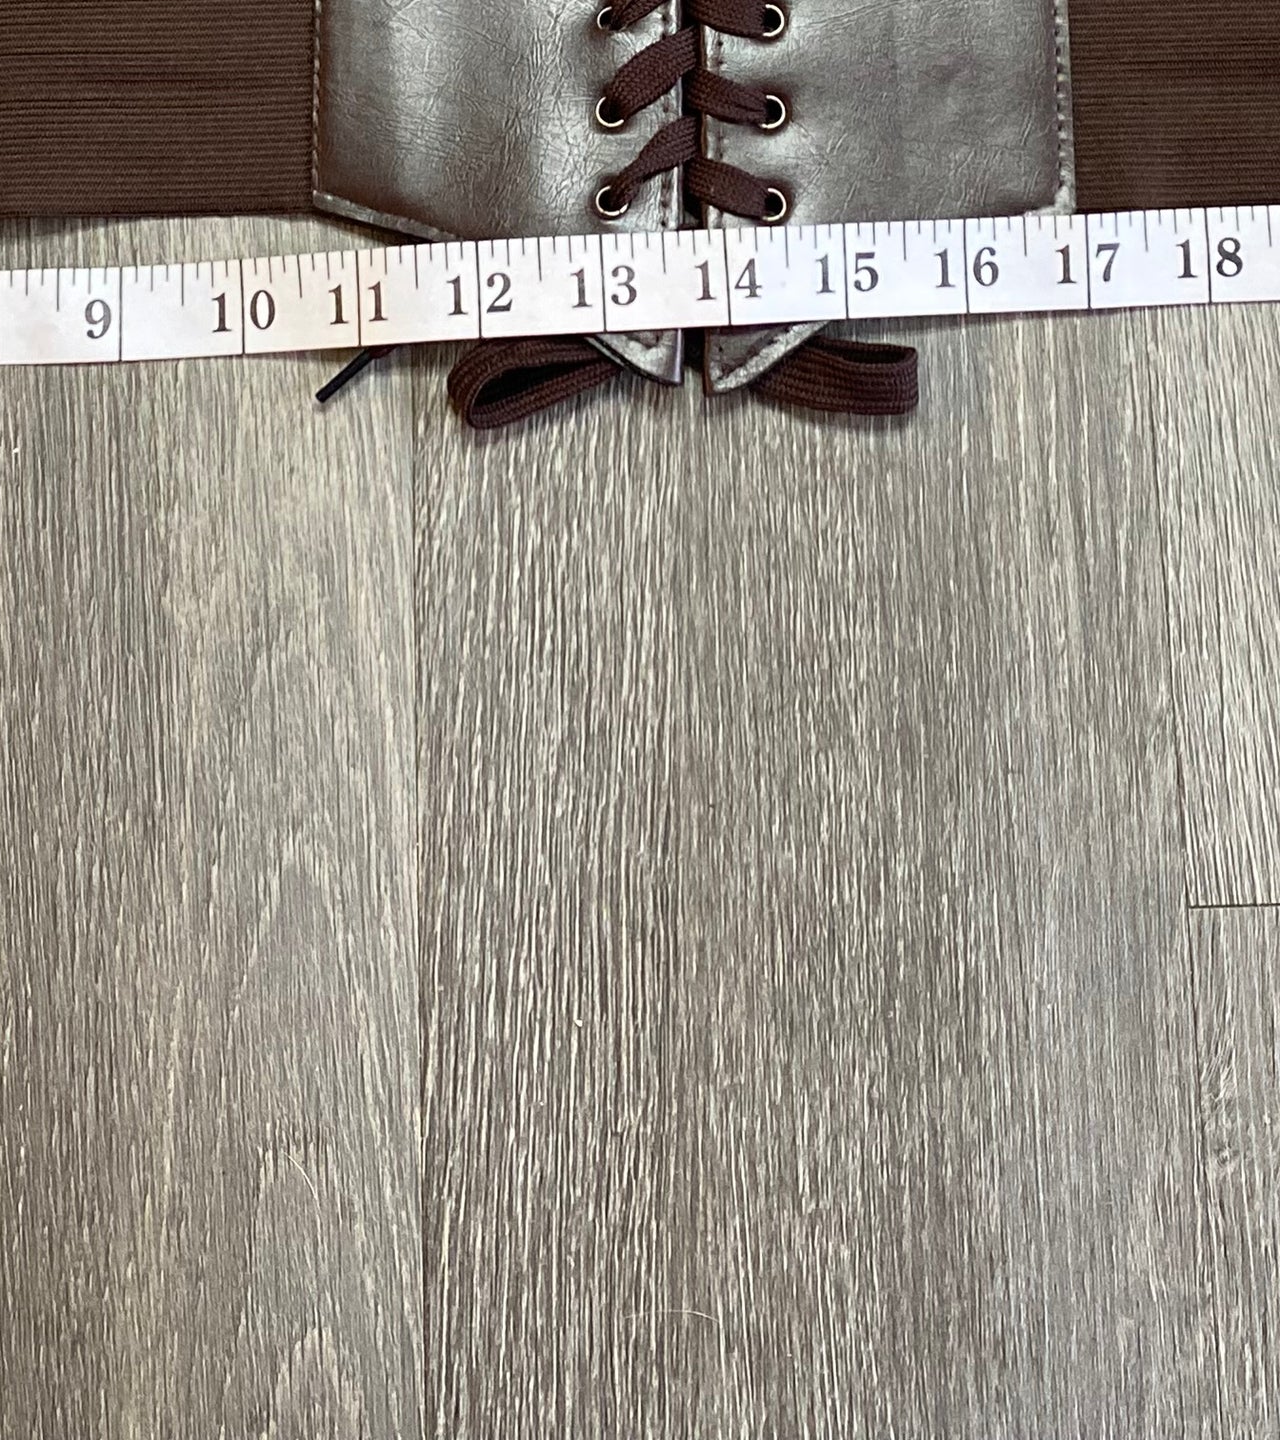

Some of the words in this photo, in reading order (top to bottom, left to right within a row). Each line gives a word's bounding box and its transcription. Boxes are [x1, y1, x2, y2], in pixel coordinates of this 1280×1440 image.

[85, 299, 112, 339] 9
[212, 289, 276, 333] 10
[329, 281, 388, 325] 11
[447, 272, 513, 316] 12
[571, 265, 637, 309] 13
[694, 258, 762, 301] 14
[815, 252, 879, 294] 15
[934, 247, 999, 288] 16
[1055, 242, 1121, 284] 17
[1176, 237, 1243, 279] 18
